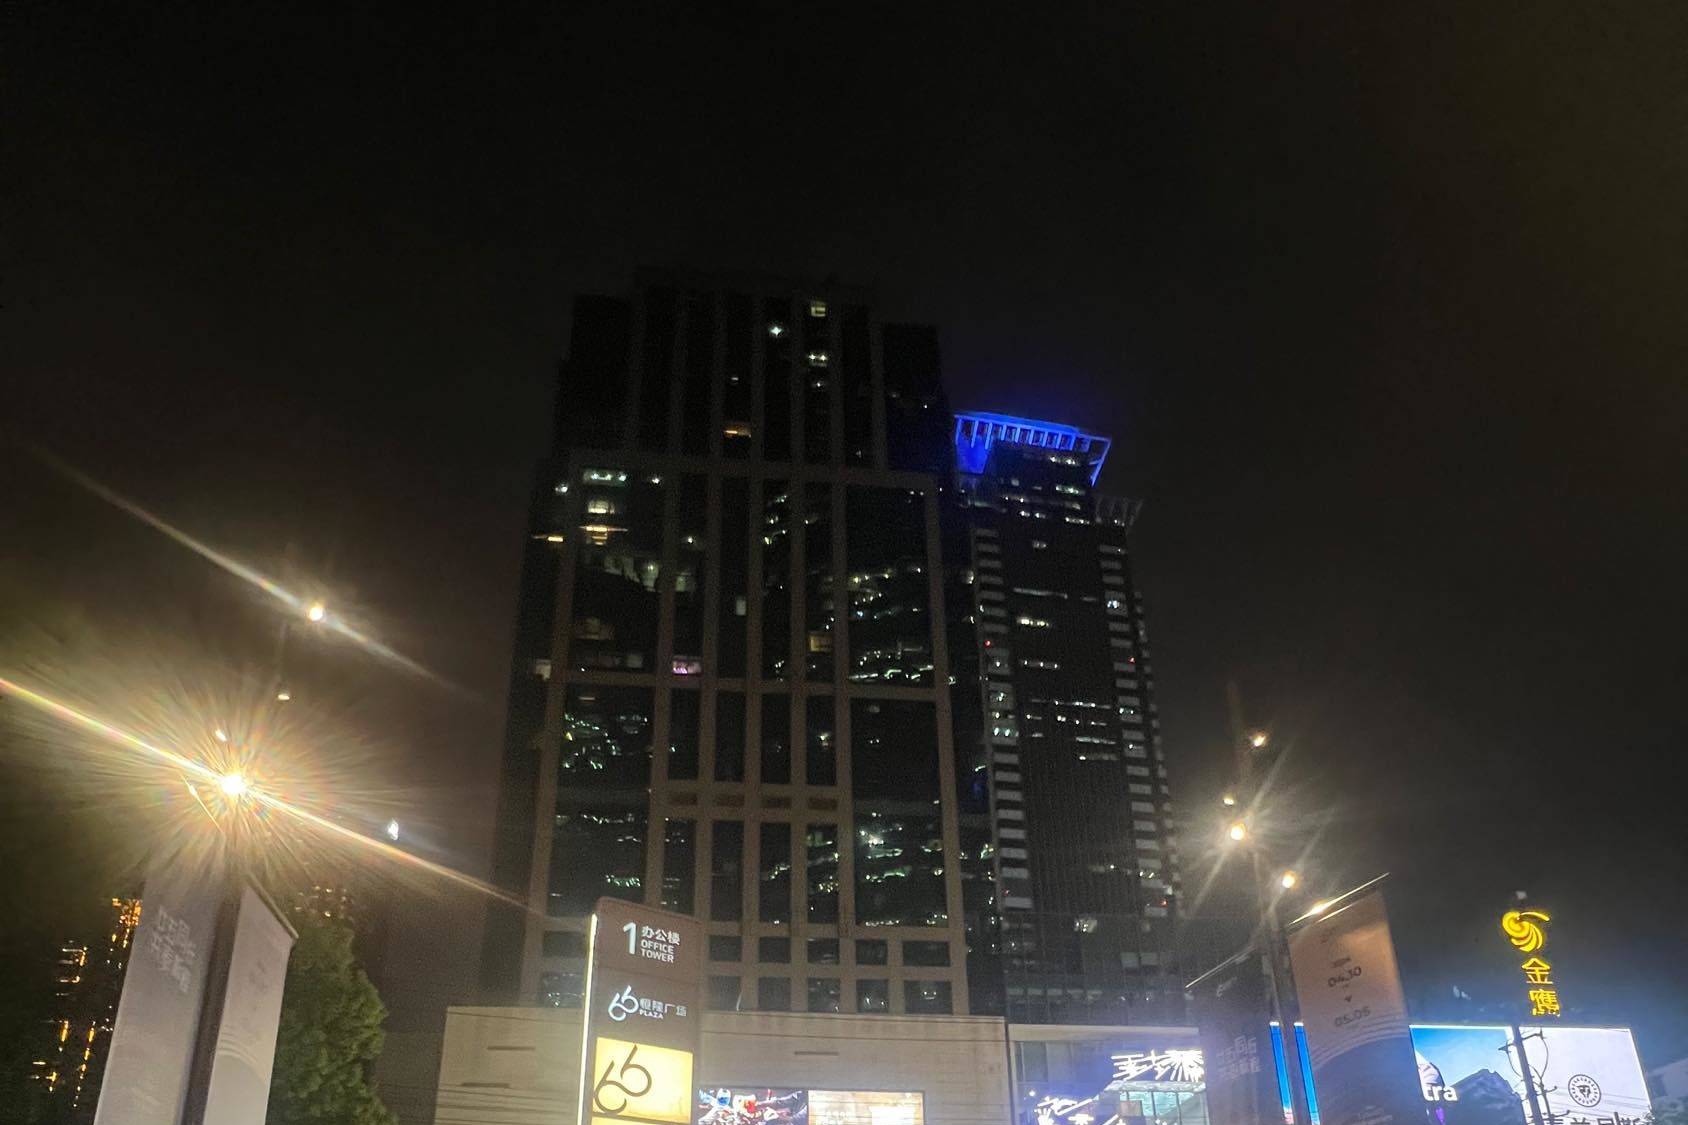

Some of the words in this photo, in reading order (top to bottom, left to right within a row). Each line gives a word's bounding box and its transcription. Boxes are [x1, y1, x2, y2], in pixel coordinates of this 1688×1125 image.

[623, 921, 637, 955] 1
[641, 925, 681, 946] 办公楼
[641, 939, 674, 955] OFFICE
[641, 948, 675, 963] TOWER
[608, 984, 640, 1022] 66
[639, 1009, 664, 1020] PLAZA
[593, 1043, 653, 1115] 66
